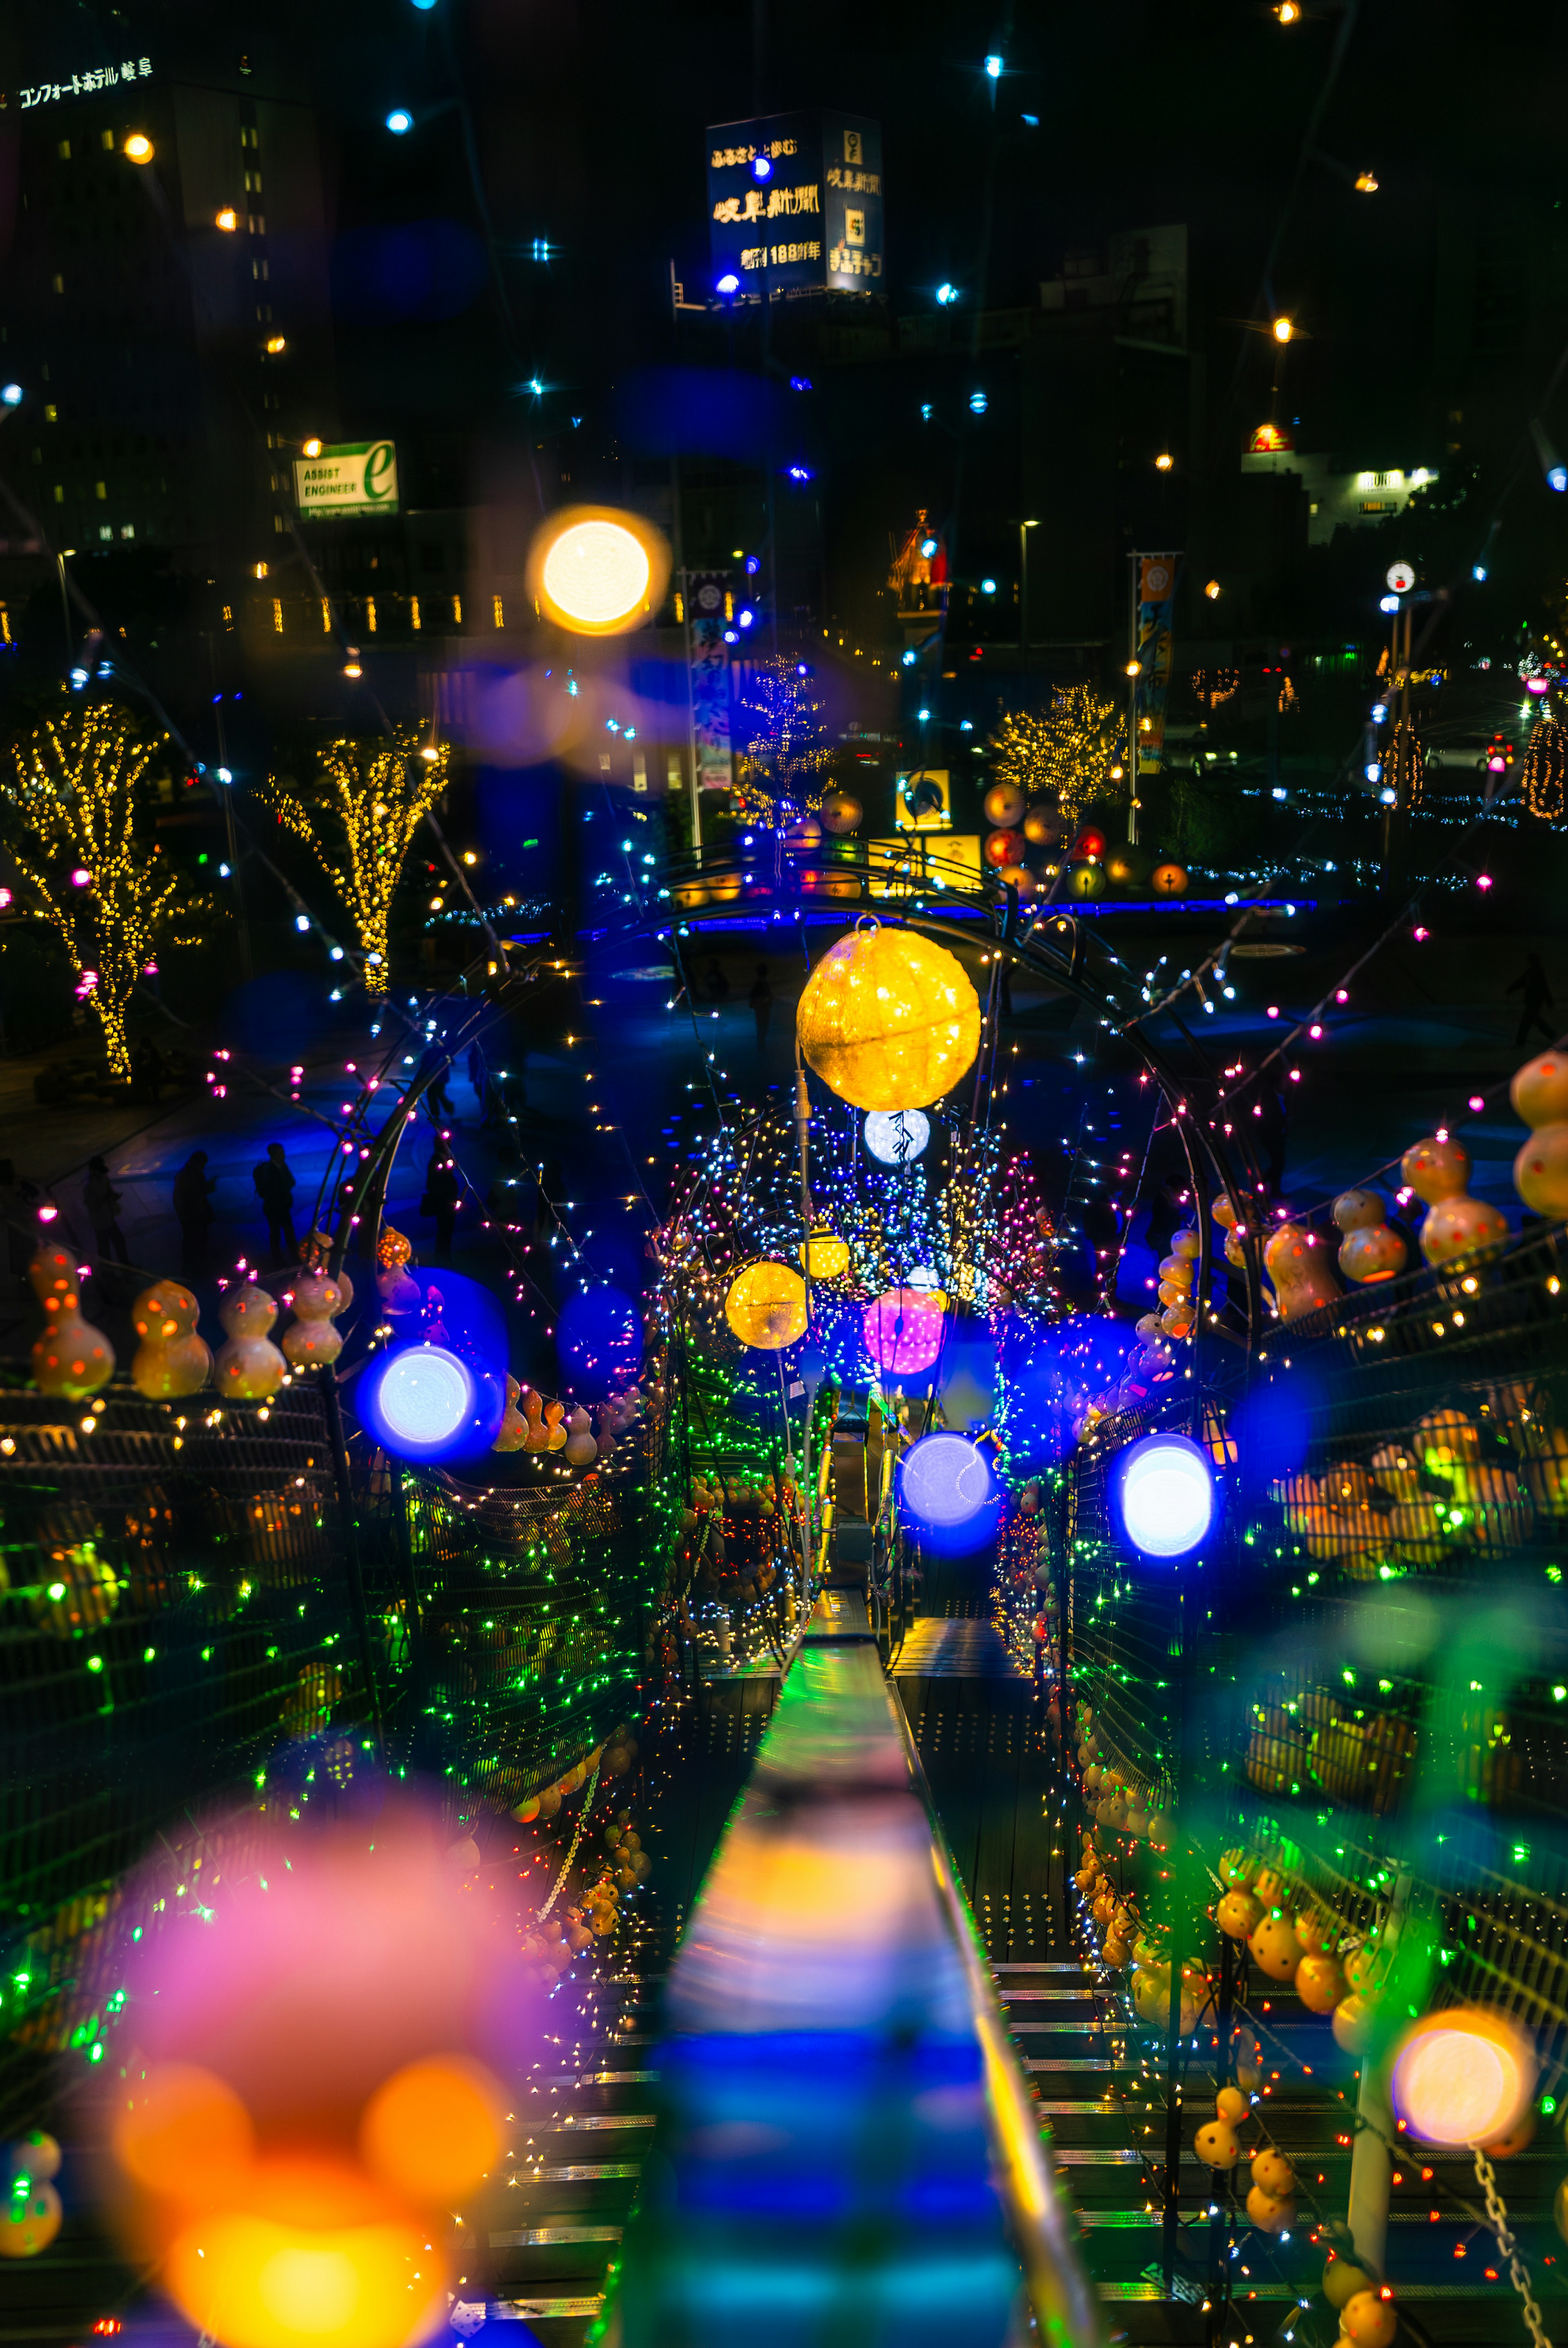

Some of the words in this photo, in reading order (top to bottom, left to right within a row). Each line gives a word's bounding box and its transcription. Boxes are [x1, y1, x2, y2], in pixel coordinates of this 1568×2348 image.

[713, 184, 820, 223] 岐阜新聞
[304, 468, 341, 482] ASSIST
[305, 483, 356, 497] ENGINEER
